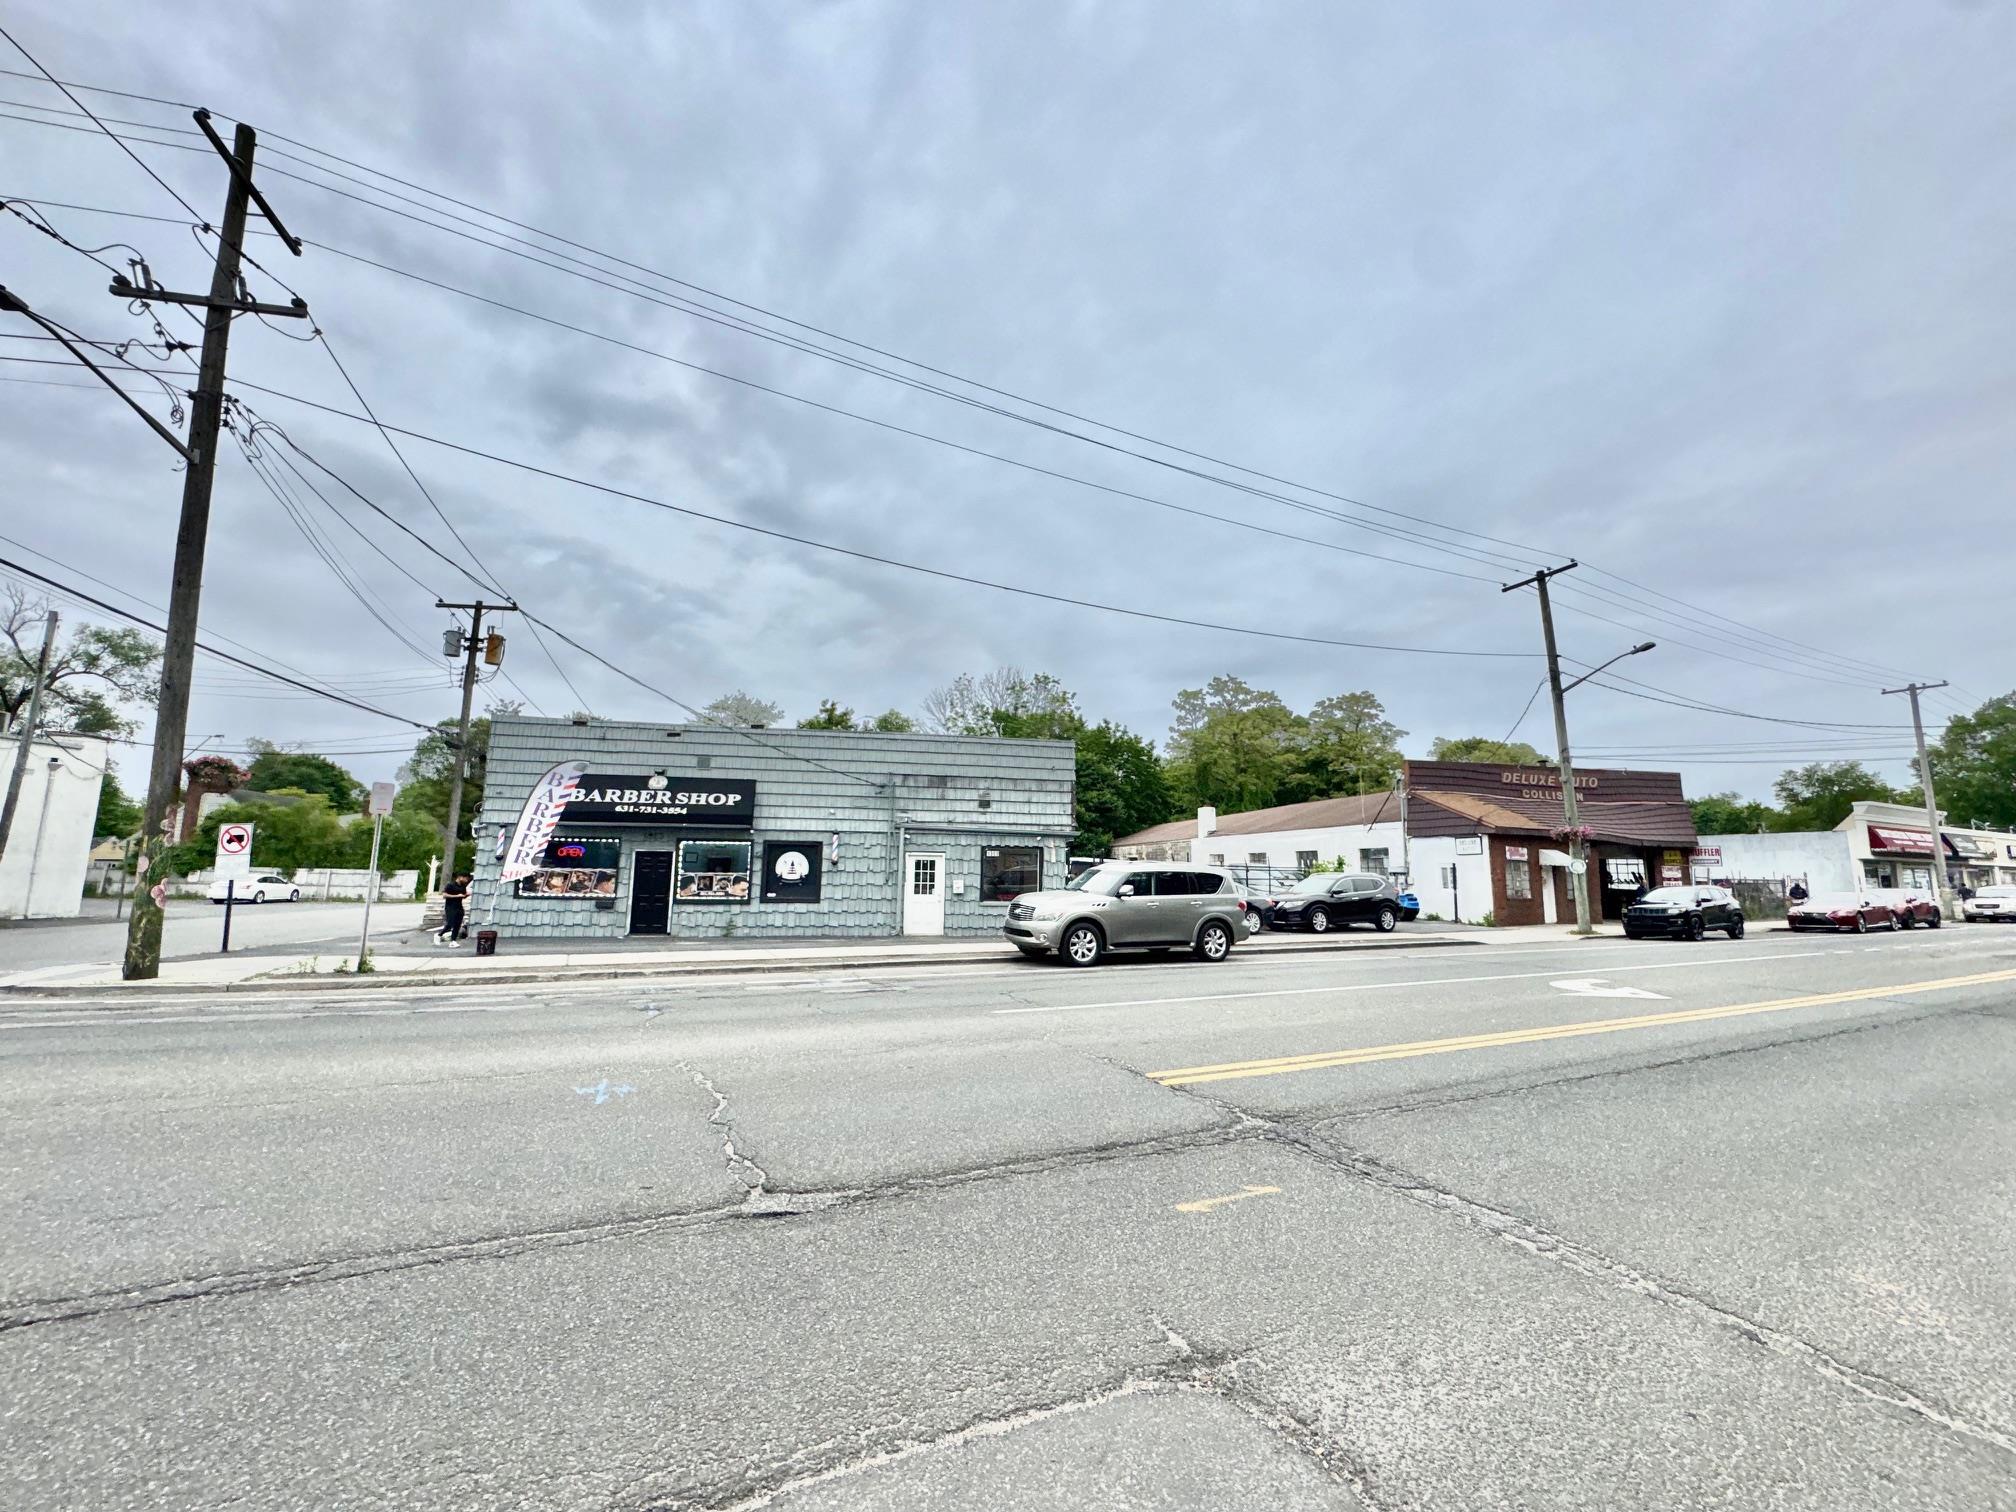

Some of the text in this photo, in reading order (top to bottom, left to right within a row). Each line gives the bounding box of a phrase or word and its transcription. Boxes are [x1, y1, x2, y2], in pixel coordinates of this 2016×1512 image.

[1502, 772, 1598, 788] DELUXE UTO
[570, 789, 742, 806] BARBER SHOP
[1523, 789, 1584, 801] COLLISN
[514, 771, 564, 865] BARBER
